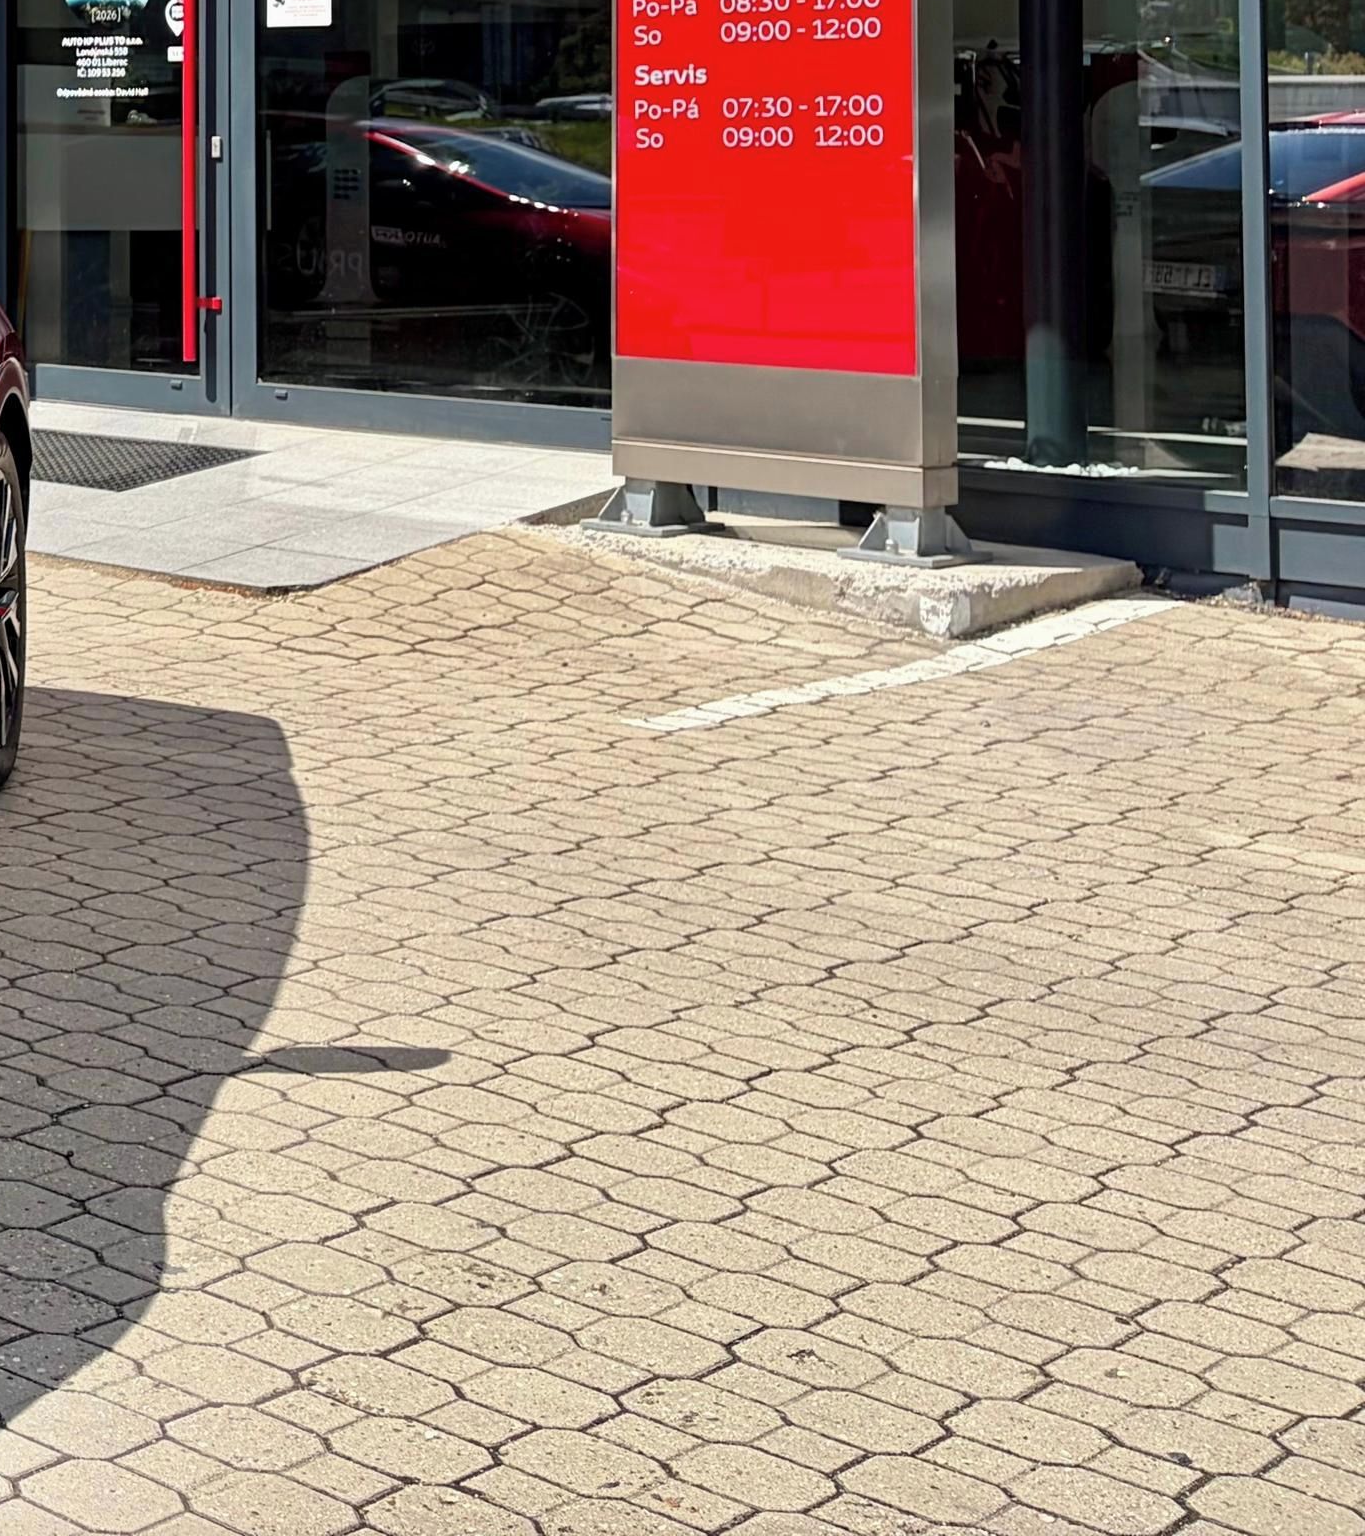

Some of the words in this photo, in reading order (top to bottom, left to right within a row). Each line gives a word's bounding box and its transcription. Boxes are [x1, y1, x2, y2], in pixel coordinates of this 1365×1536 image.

[633, 24, 662, 46] So
[720, 19, 792, 43] 09:00
[812, 17, 882, 40] 12:00
[634, 63, 708, 86] Servis
[634, 97, 700, 120] Po-Pá
[722, 96, 793, 119] 07:30
[814, 94, 884, 117] 17:00
[635, 127, 665, 149] So
[722, 126, 794, 148] 09:00
[814, 124, 885, 147] 12:00
